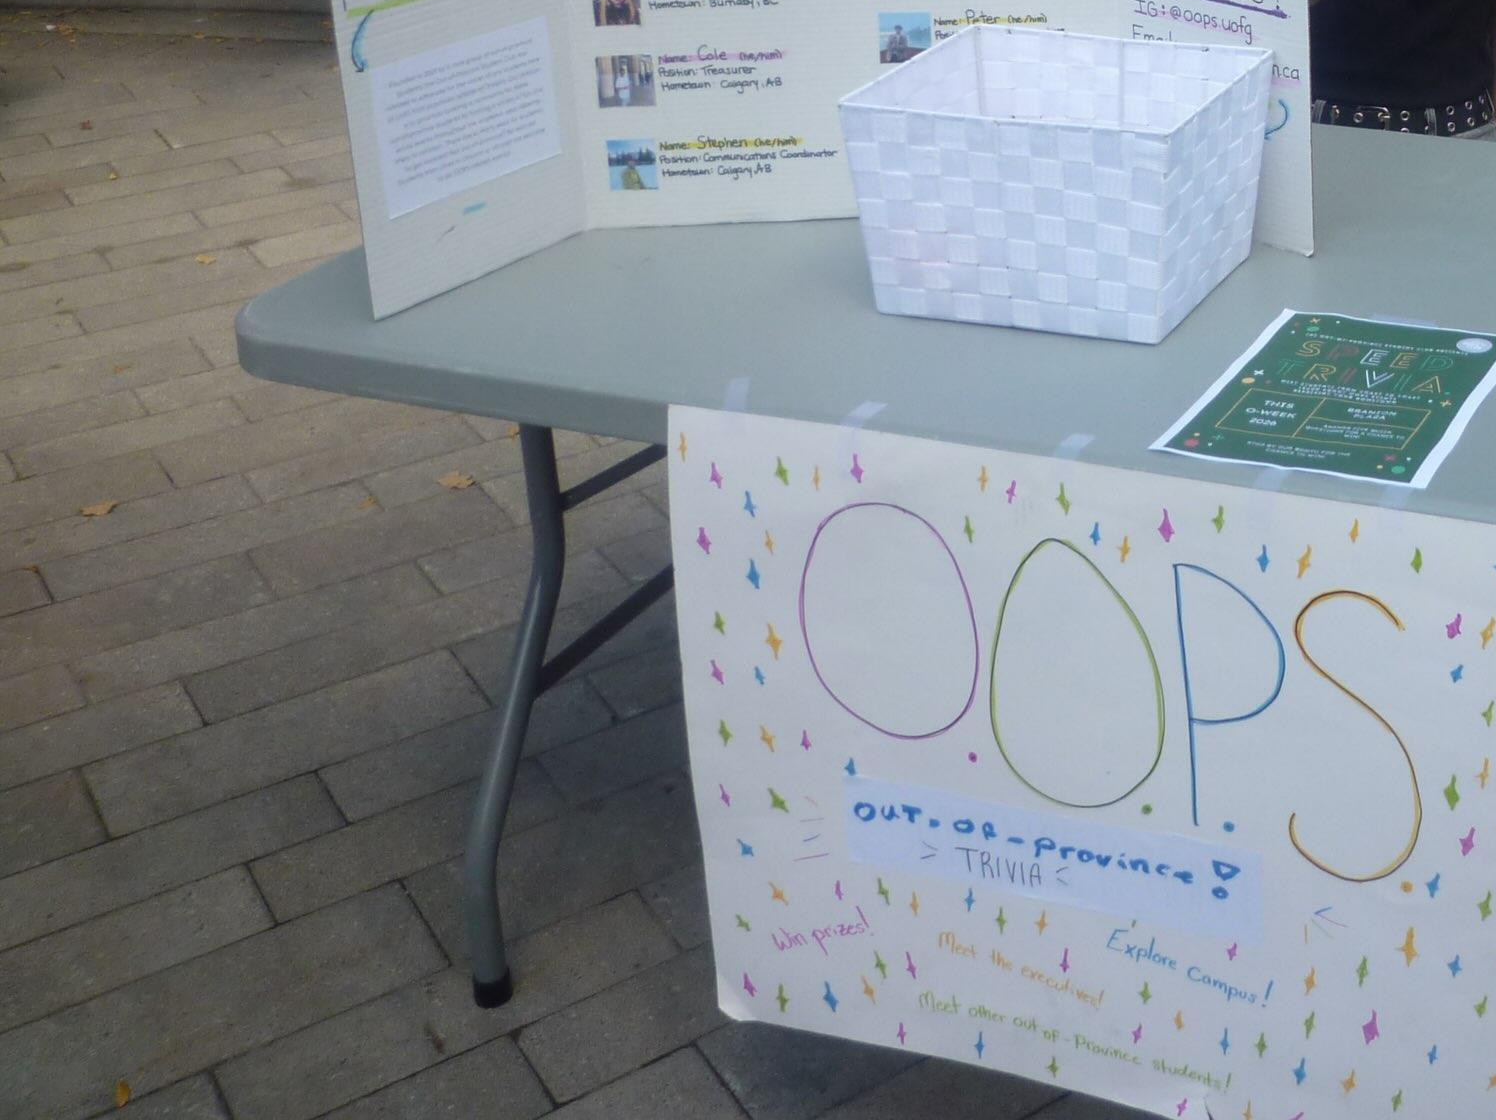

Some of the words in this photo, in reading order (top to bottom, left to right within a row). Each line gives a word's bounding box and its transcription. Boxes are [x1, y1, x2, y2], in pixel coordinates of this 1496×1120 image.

[697, 44, 728, 62] Cole
[701, 63, 758, 76] Treasurer
[766, 76, 783, 88] AB
[697, 135, 749, 151] Stephen
[755, 162, 773, 175] AB
[1296, 340, 1454, 371] SPEED
[1277, 359, 1443, 394] TRIVIA
[1245, 407, 1297, 419] O-WEEK
[1264, 399, 1296, 409] THIS
[954, 846, 1042, 887] TRIVIA
[771, 927, 808, 951] Win
[811, 905, 874, 956] prizes!
[938, 931, 977, 958] Meet
[991, 948, 1012, 970] the
[1106, 928, 1177, 970] Explore
[1187, 966, 1273, 1008] Campus!
[918, 990, 958, 1014] Meet
[967, 1004, 1004, 1023] other
